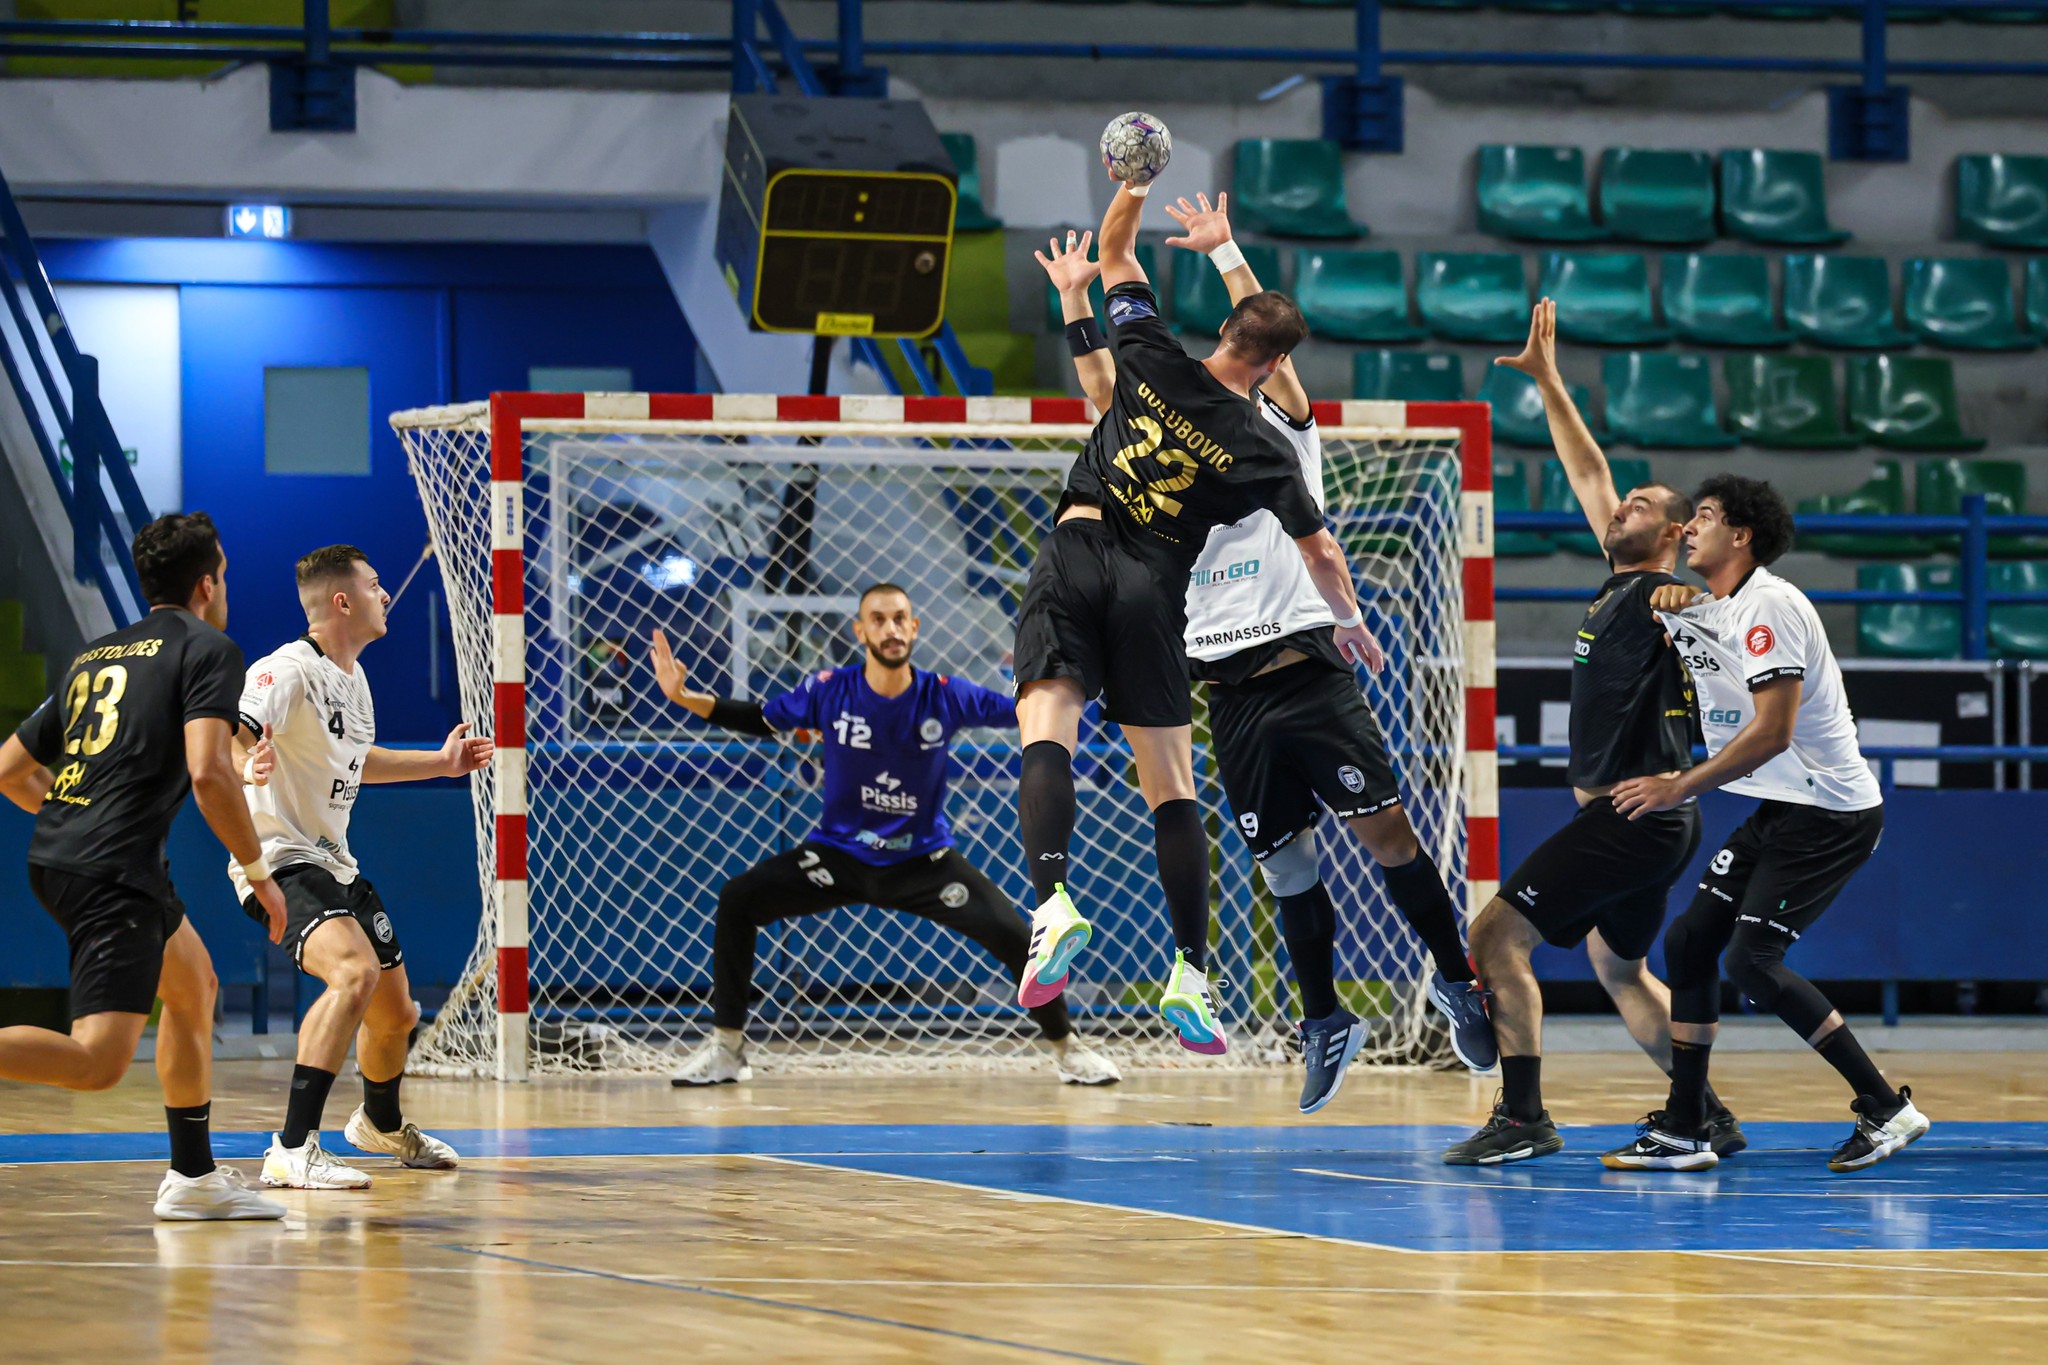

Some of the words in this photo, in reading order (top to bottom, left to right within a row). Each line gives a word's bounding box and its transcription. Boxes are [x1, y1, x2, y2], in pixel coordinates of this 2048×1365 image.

[1112, 415, 1198, 517] 22
[1195, 622, 1282, 647] PARNASSOS
[1682, 651, 1720, 671] ssis
[64, 665, 128, 756] 23
[328, 711, 345, 739] 4
[833, 719, 872, 750] 12
[861, 785, 918, 810] Pissis
[1239, 811, 1259, 838] 9
[798, 850, 835, 888] 12
[1710, 849, 1735, 875] 9
[324, 908, 348, 916] Kempa
